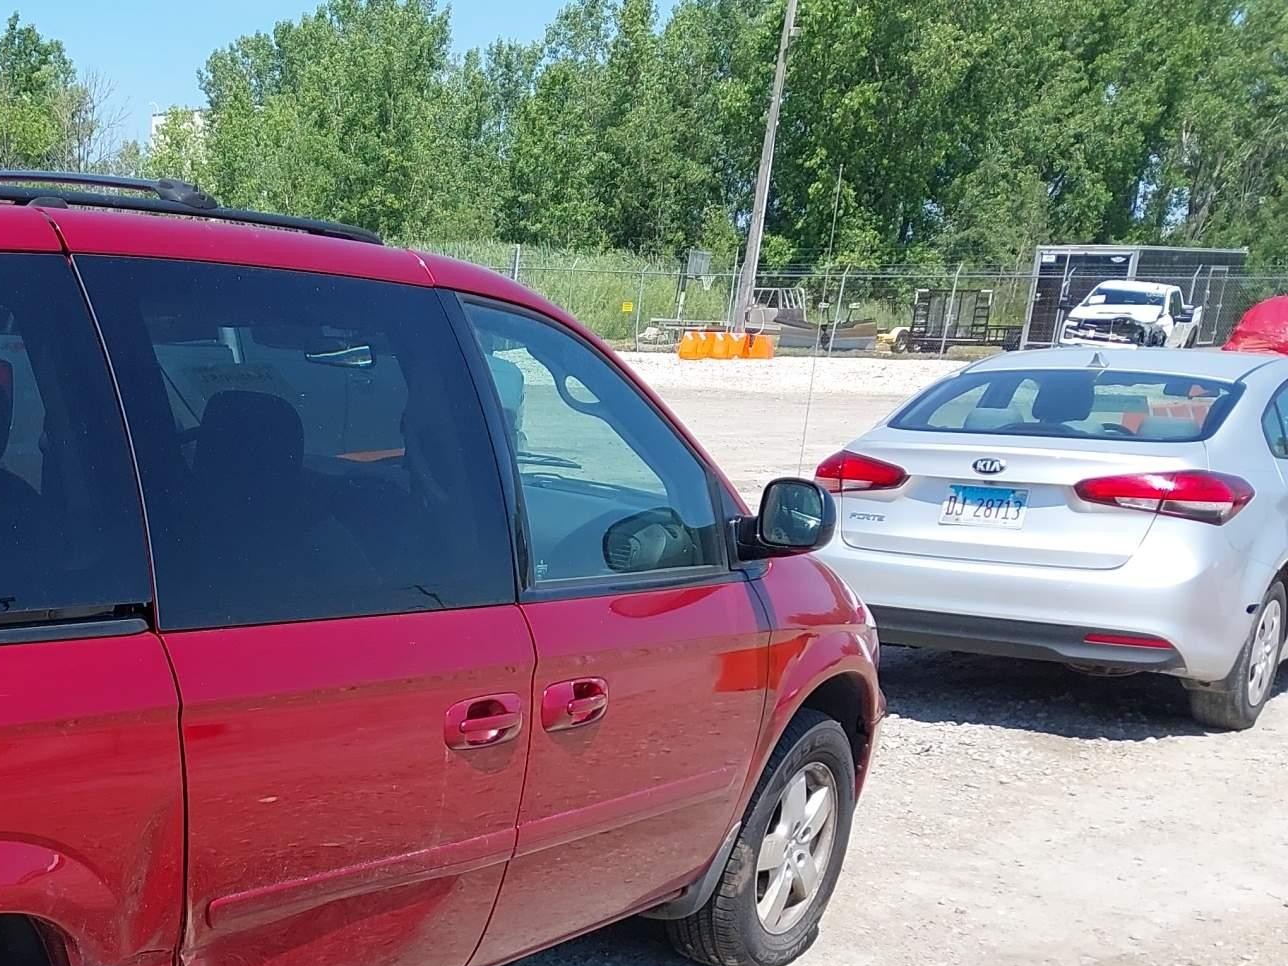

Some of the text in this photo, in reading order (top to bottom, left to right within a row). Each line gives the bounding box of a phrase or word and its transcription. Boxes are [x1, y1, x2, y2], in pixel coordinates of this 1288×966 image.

[945, 495, 1022, 520] DJ 28713
[848, 512, 886, 522] FORTE
